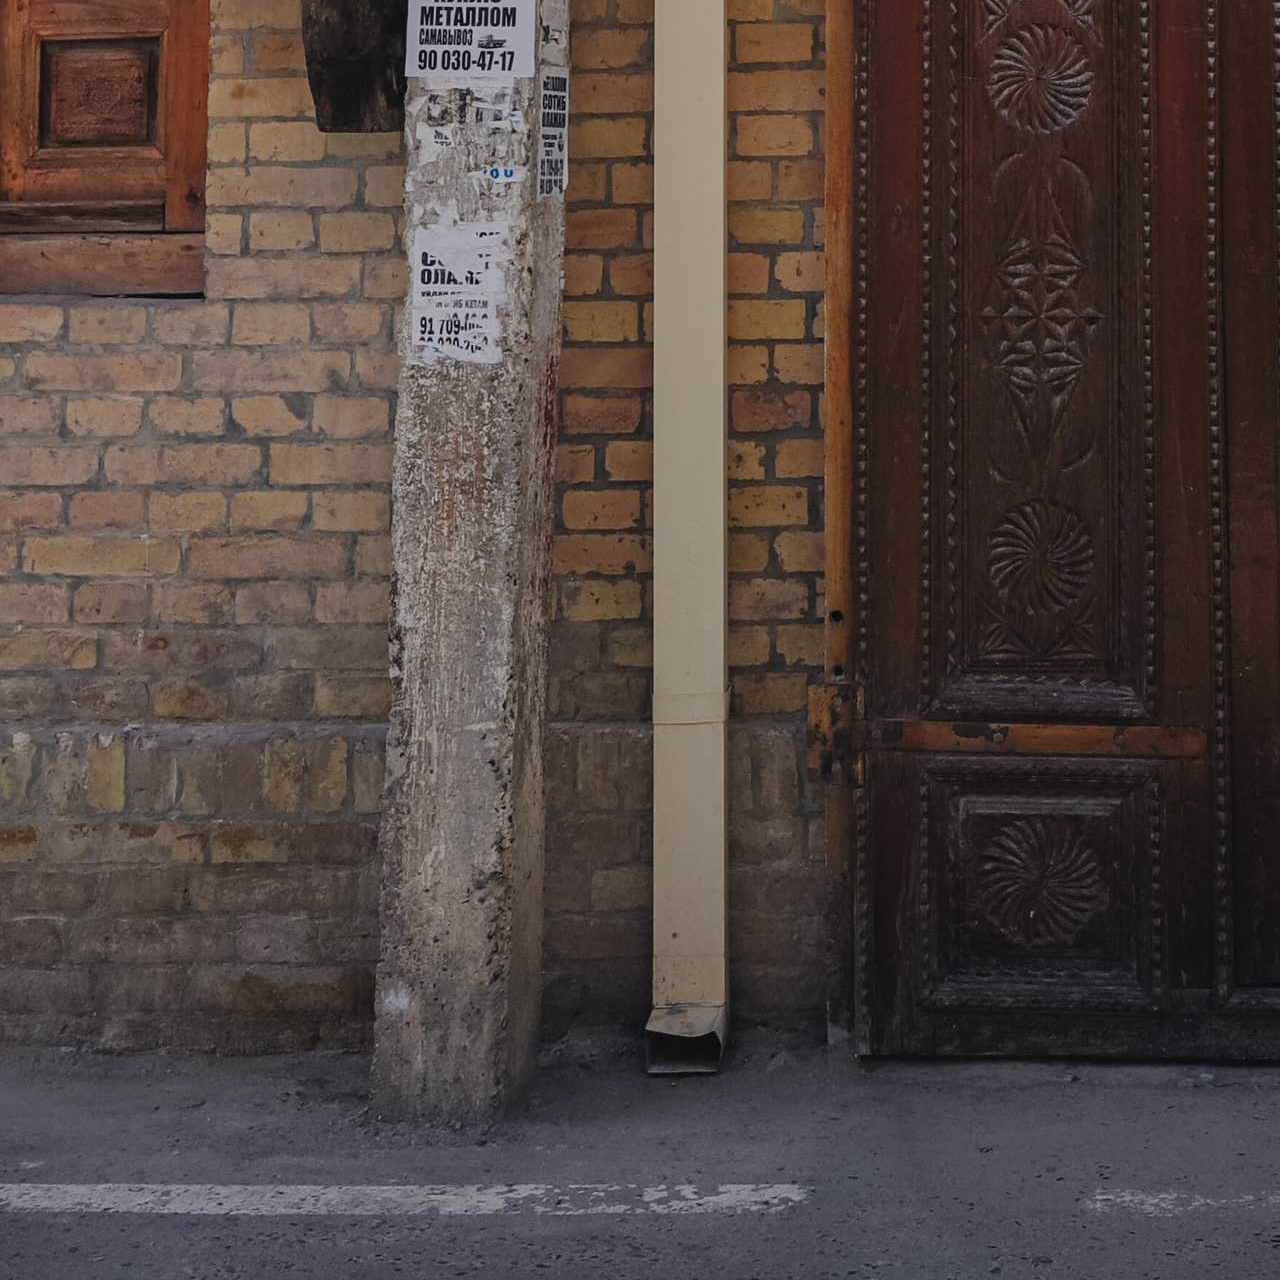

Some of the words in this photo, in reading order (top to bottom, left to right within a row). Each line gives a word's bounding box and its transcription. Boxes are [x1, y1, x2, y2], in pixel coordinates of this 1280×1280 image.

[420, 6, 517, 27] МЕТАЛЛОМ
[419, 28, 474, 46] САМАВЫВОЗ
[418, 49, 438, 71] 90
[441, 49, 515, 71] 030-47-17
[542, 93, 566, 111] СОТИБ
[420, 316, 435, 335] 91
